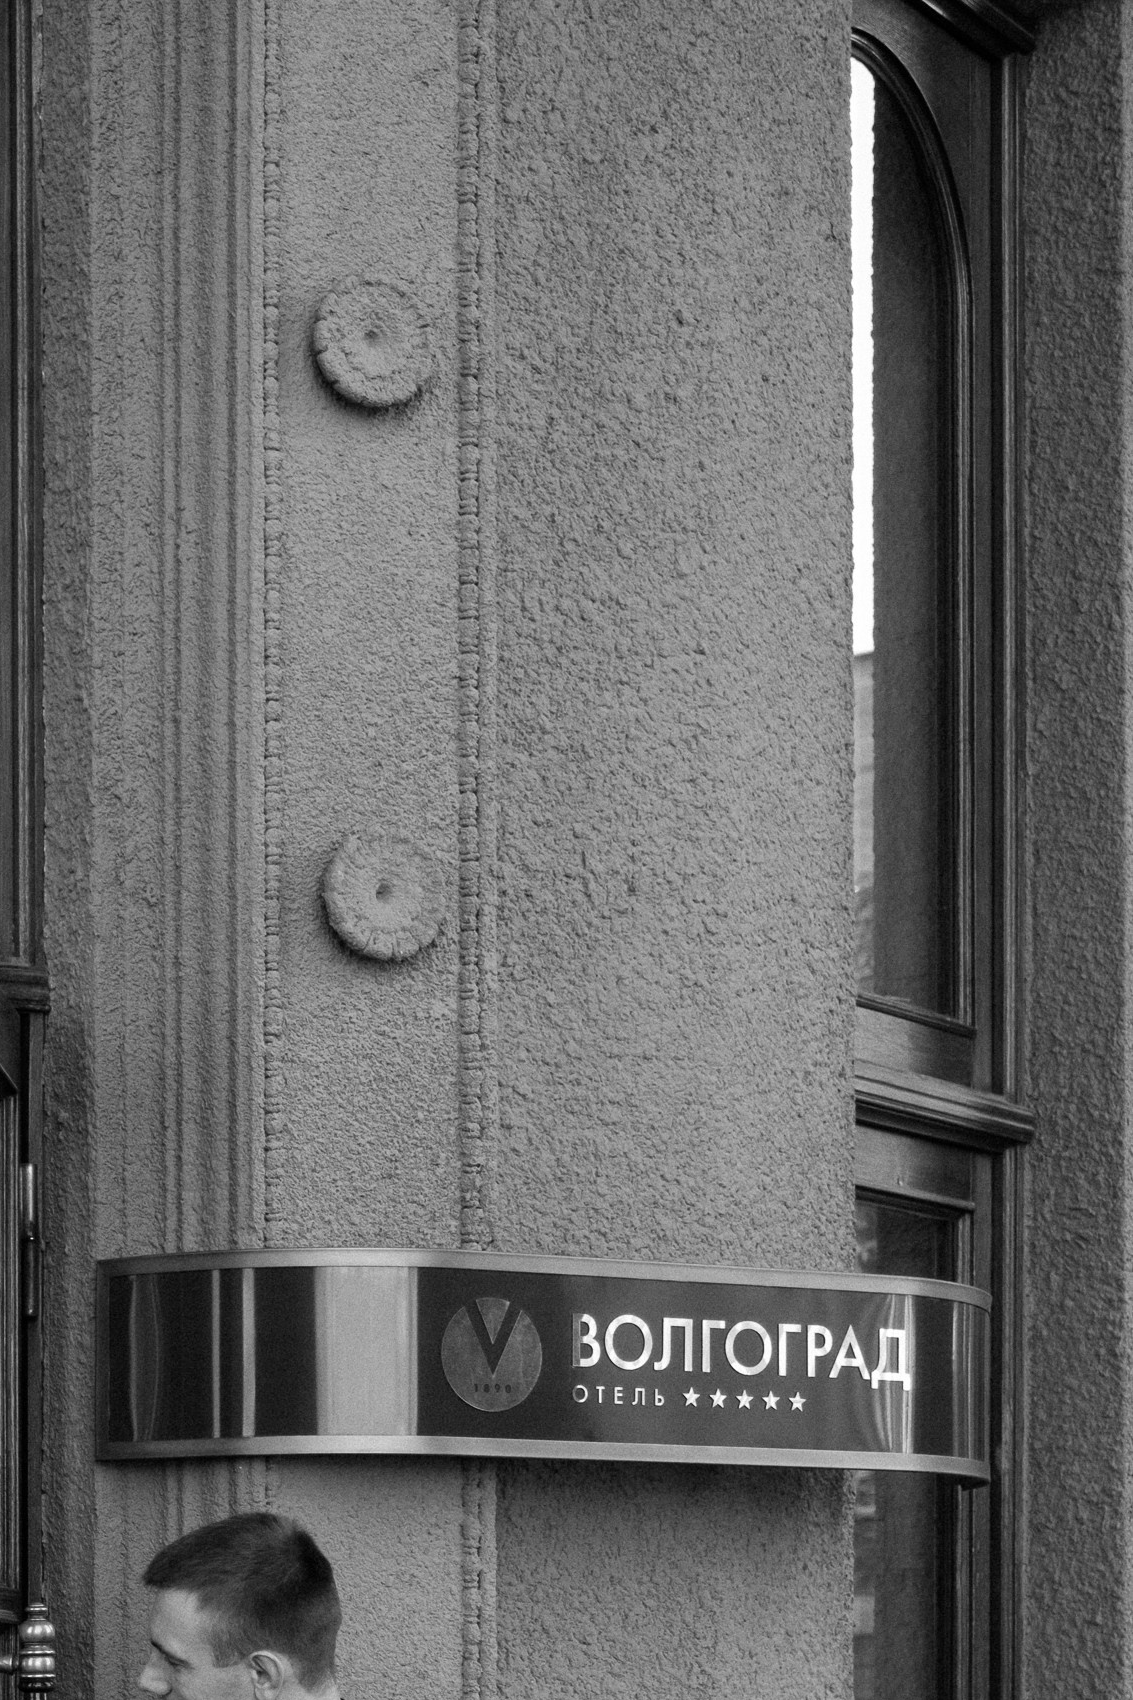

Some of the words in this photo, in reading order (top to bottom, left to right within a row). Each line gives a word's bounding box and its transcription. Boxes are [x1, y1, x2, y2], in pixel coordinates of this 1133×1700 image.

[572, 1313, 912, 1391] ВОЛГОГРАД
[474, 1383, 512, 1394] 1890
[572, 1384, 665, 1406] ОТЕЛЬ
